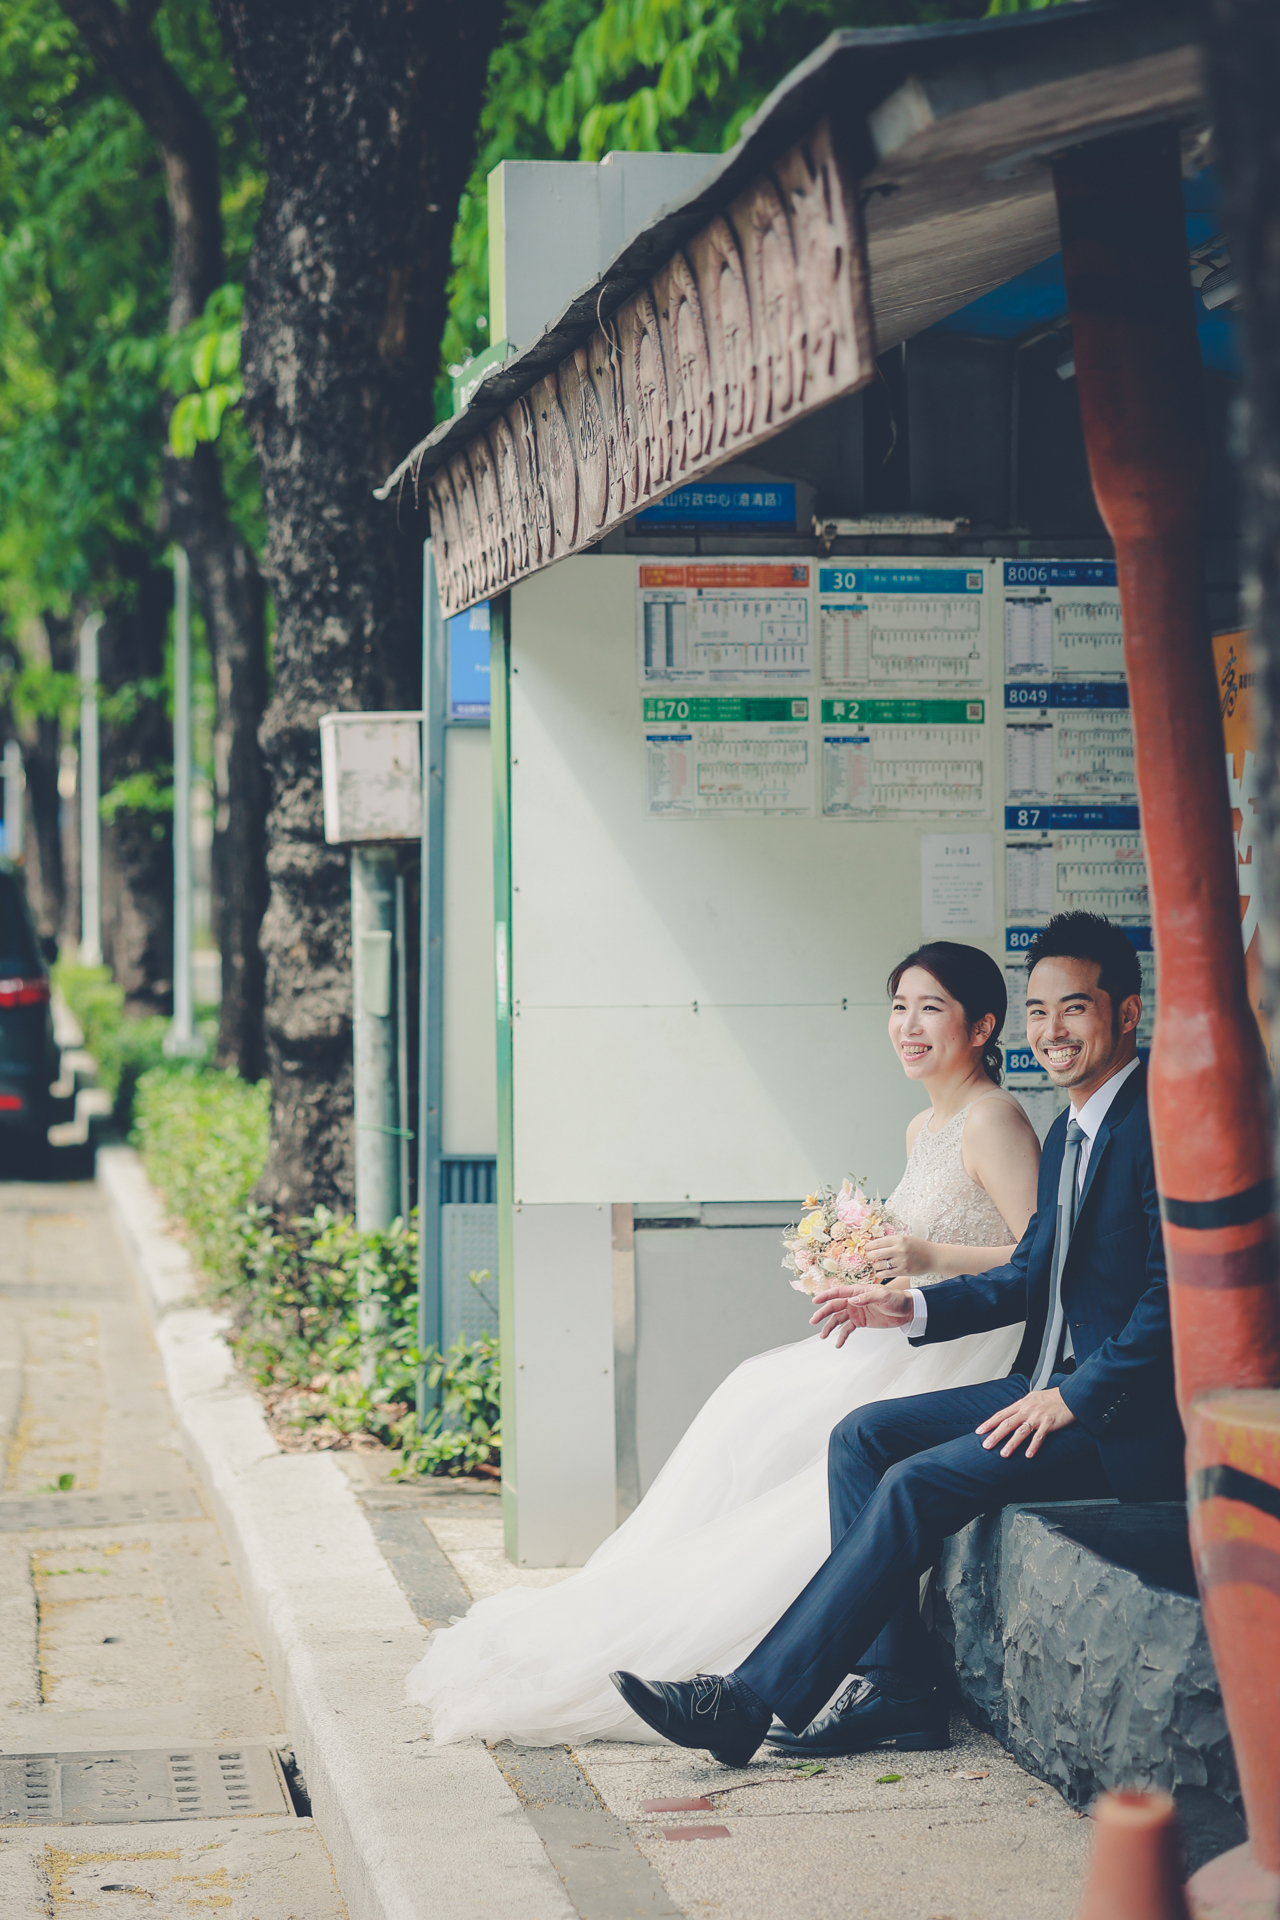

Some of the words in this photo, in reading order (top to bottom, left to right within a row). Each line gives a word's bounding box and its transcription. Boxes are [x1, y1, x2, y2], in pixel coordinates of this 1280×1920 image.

[833, 572, 856, 590] 30
[1007, 566, 1048, 582] 8006
[1009, 689, 1048, 703] 8049
[665, 701, 689, 718] 70
[1017, 809, 1041, 826] 87
[1010, 932, 1043, 948] 804
[1010, 1053, 1043, 1069] 804
